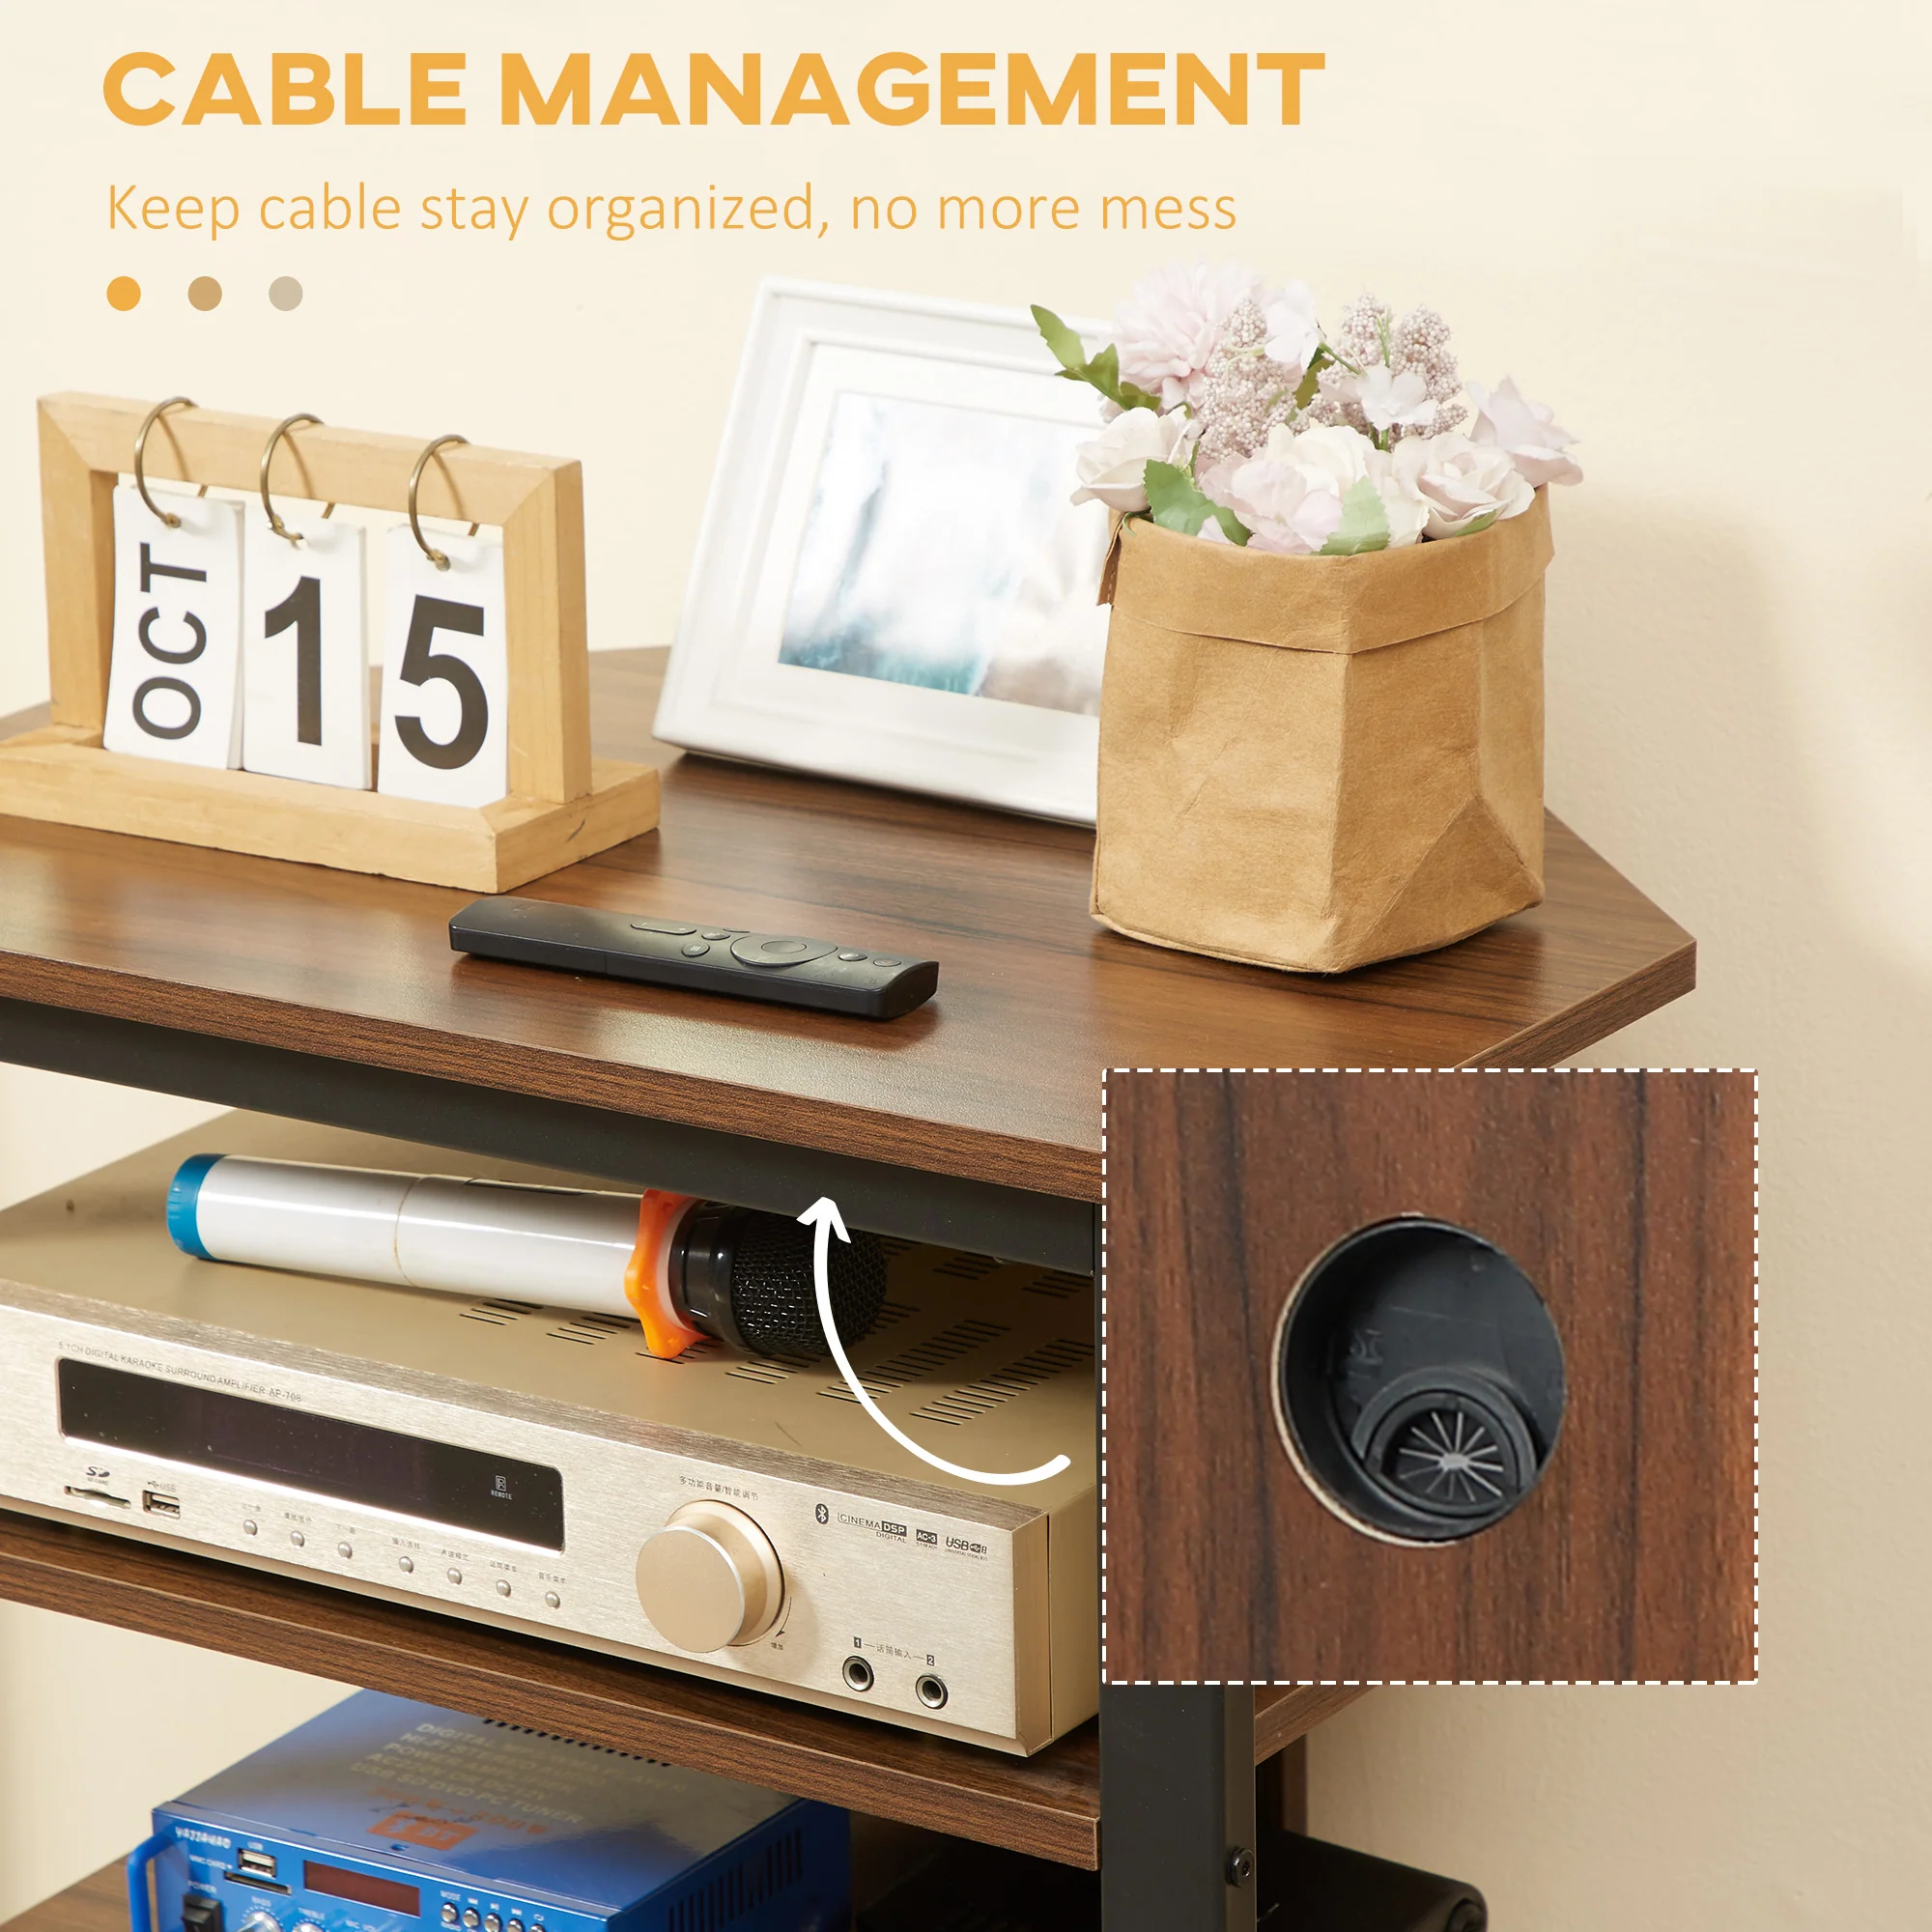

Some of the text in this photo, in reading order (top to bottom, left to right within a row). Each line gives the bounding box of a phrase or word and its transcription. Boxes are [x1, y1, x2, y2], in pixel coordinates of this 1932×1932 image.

[132, 542, 489, 770] OCT 1 5
[85, 1347, 118, 1362] DIGITAL
[121, 1355, 163, 1373] KARAOKE
[165, 1363, 215, 1383] SURROUND
[217, 1377, 266, 1395] AMPLIFIER
[270, 1387, 301, 1403] AP-708
[159, 1484, 176, 1492] USB
[491, 1490, 513, 1500] REMOTE
[876, 1531, 907, 1544] DIGITAL
[917, 1530, 937, 1544] AC-3
[946, 1537, 969, 1551] USB
[854, 1636, 862, 1649] 1
[926, 1654, 935, 1666] 2
[511, 1799, 584, 1825] TUNER
[187, 1881, 217, 1894] POWER
